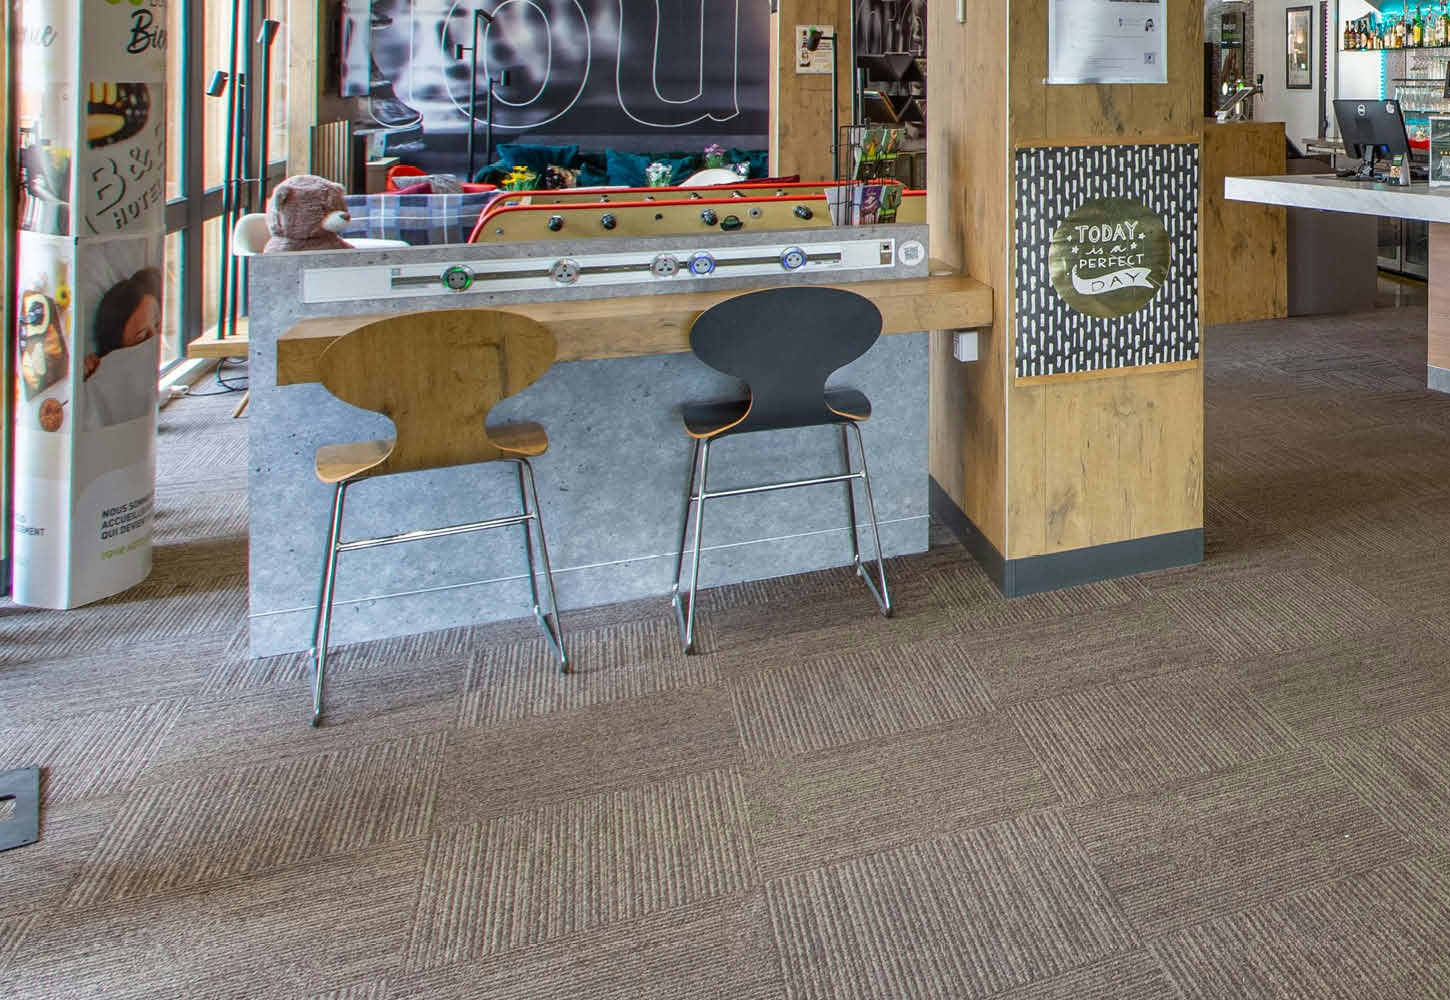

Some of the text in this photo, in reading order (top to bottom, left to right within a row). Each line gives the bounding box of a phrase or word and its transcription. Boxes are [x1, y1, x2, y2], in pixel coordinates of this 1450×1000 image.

[1074, 220, 1139, 244] TODAY
[1085, 244, 1126, 256] is a
[1079, 253, 1145, 270] PERFECT
[1091, 271, 1141, 293] DAY
[102, 503, 127, 518] NOUS
